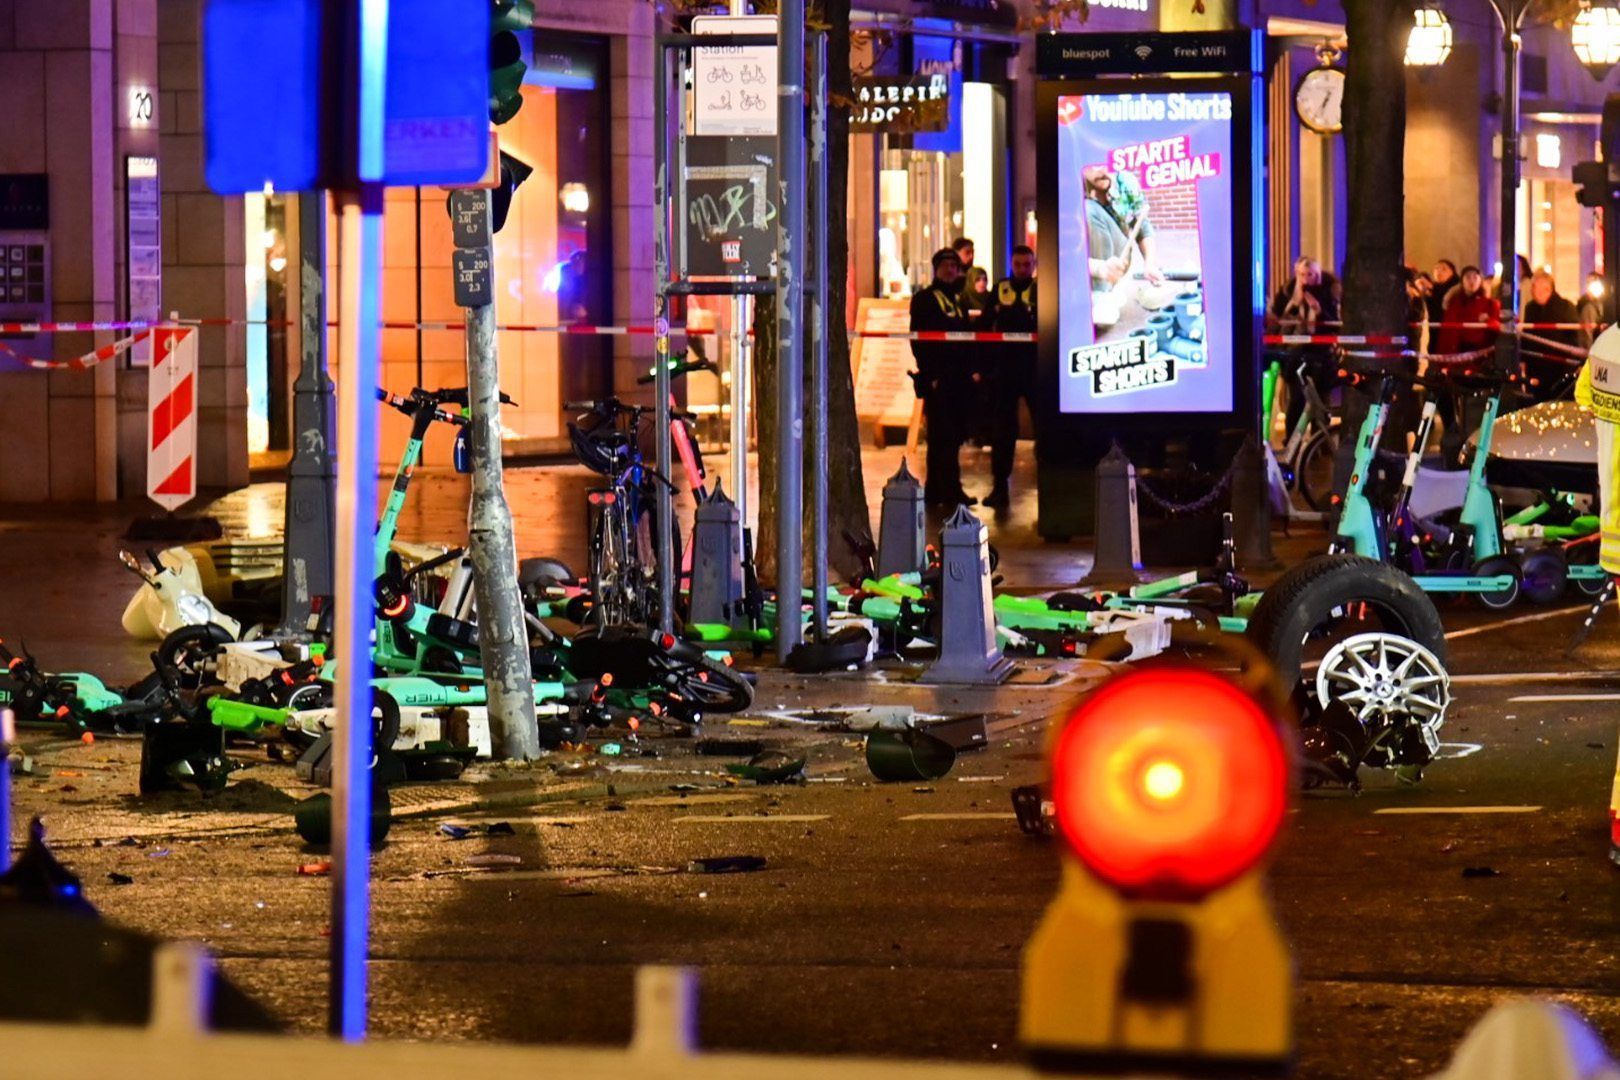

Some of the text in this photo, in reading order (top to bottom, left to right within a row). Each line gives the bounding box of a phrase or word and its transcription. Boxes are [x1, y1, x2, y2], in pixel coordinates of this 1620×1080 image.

[1062, 48, 1110, 60] bluespot
[1174, 45, 1226, 57] Free WiFi
[1086, 92, 1232, 121] YouTube Shorts
[1112, 136, 1186, 171] STARTE
[1145, 154, 1216, 187] GENIAL
[472, 202, 486, 211] 200
[474, 260, 488, 269] 200
[468, 283, 481, 292] 2.3
[1076, 341, 1142, 373] STARTE
[1099, 361, 1168, 393] SHORTS
[405, 693, 445, 703] TIER
